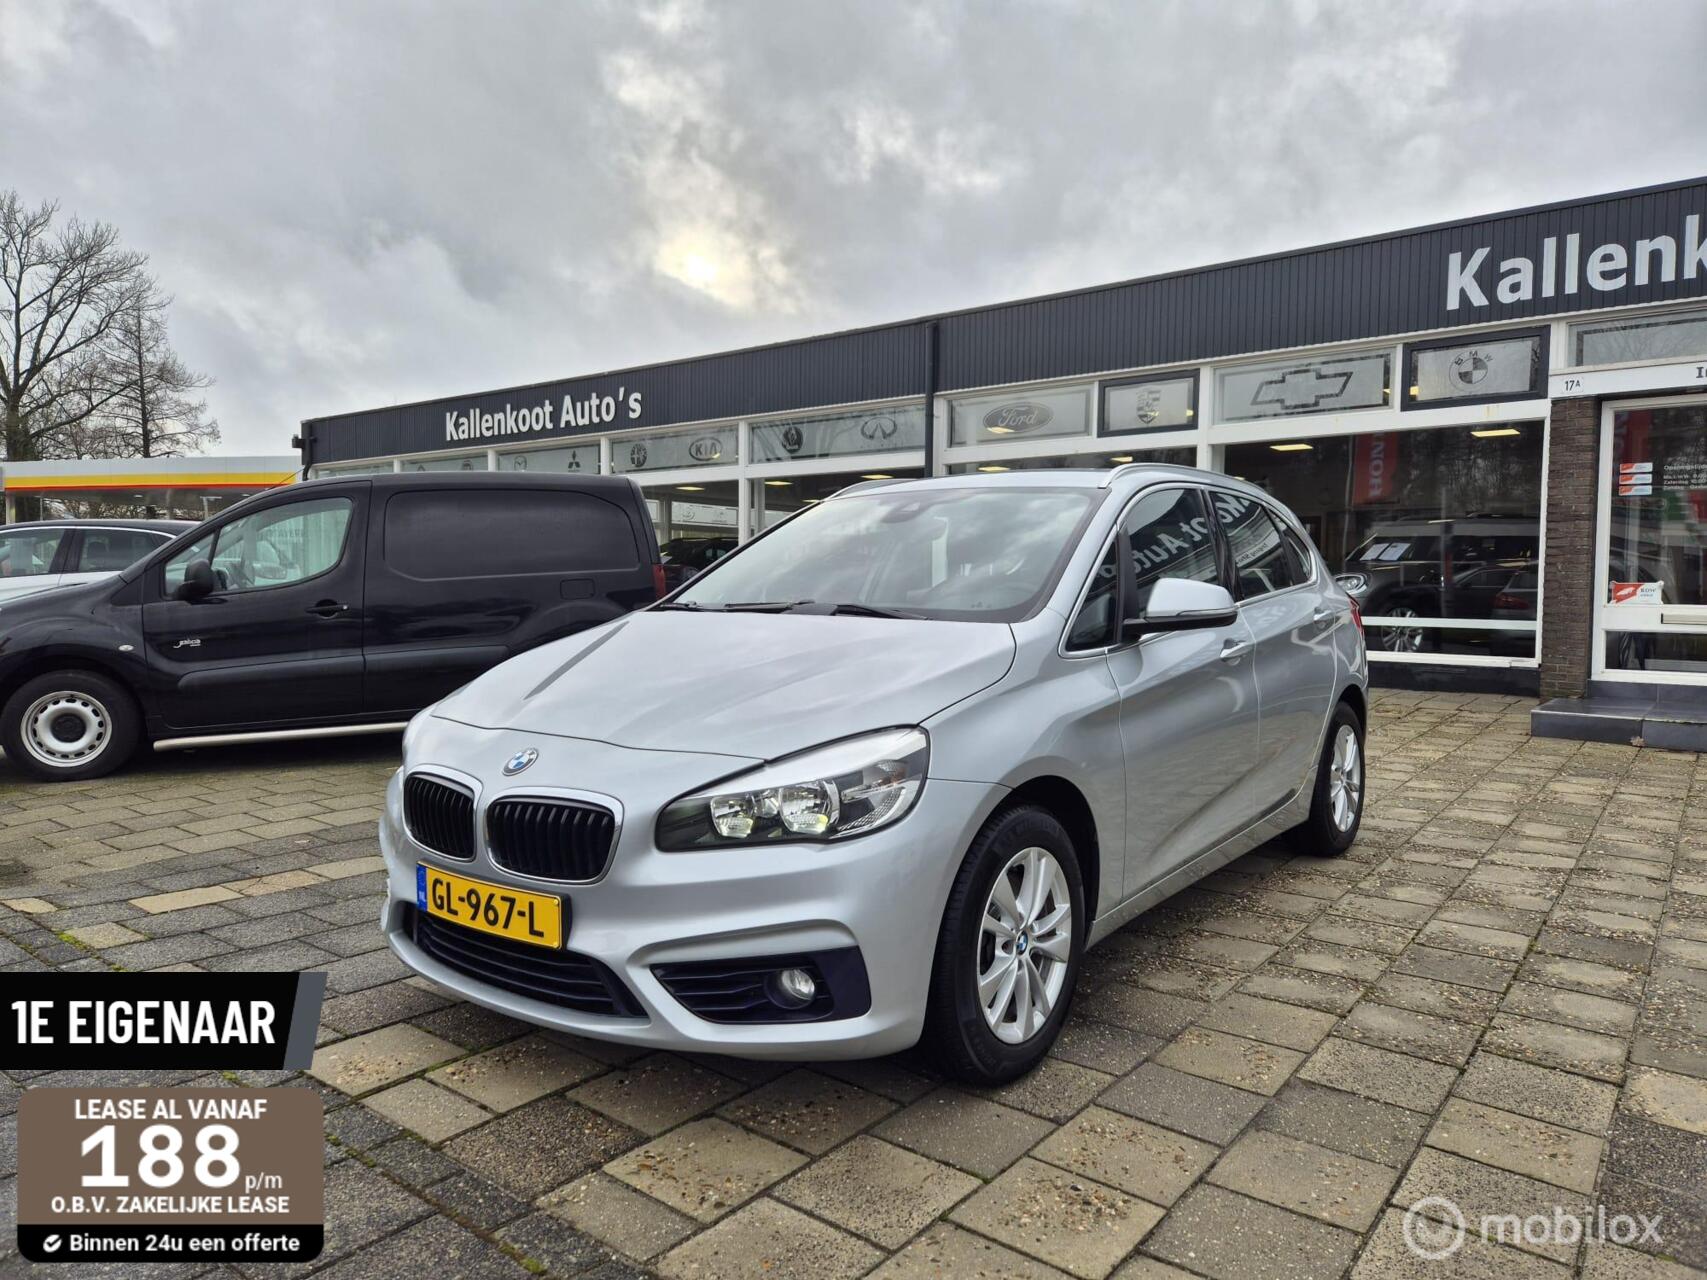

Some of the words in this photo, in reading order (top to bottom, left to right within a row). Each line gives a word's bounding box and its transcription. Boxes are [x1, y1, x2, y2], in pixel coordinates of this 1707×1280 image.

[445, 398, 554, 442] Kallenkoot
[559, 386, 643, 428] Auto's
[998, 405, 1039, 426] Ford
[695, 442, 718, 456] KIA
[432, 877, 545, 938] GL-967-L
